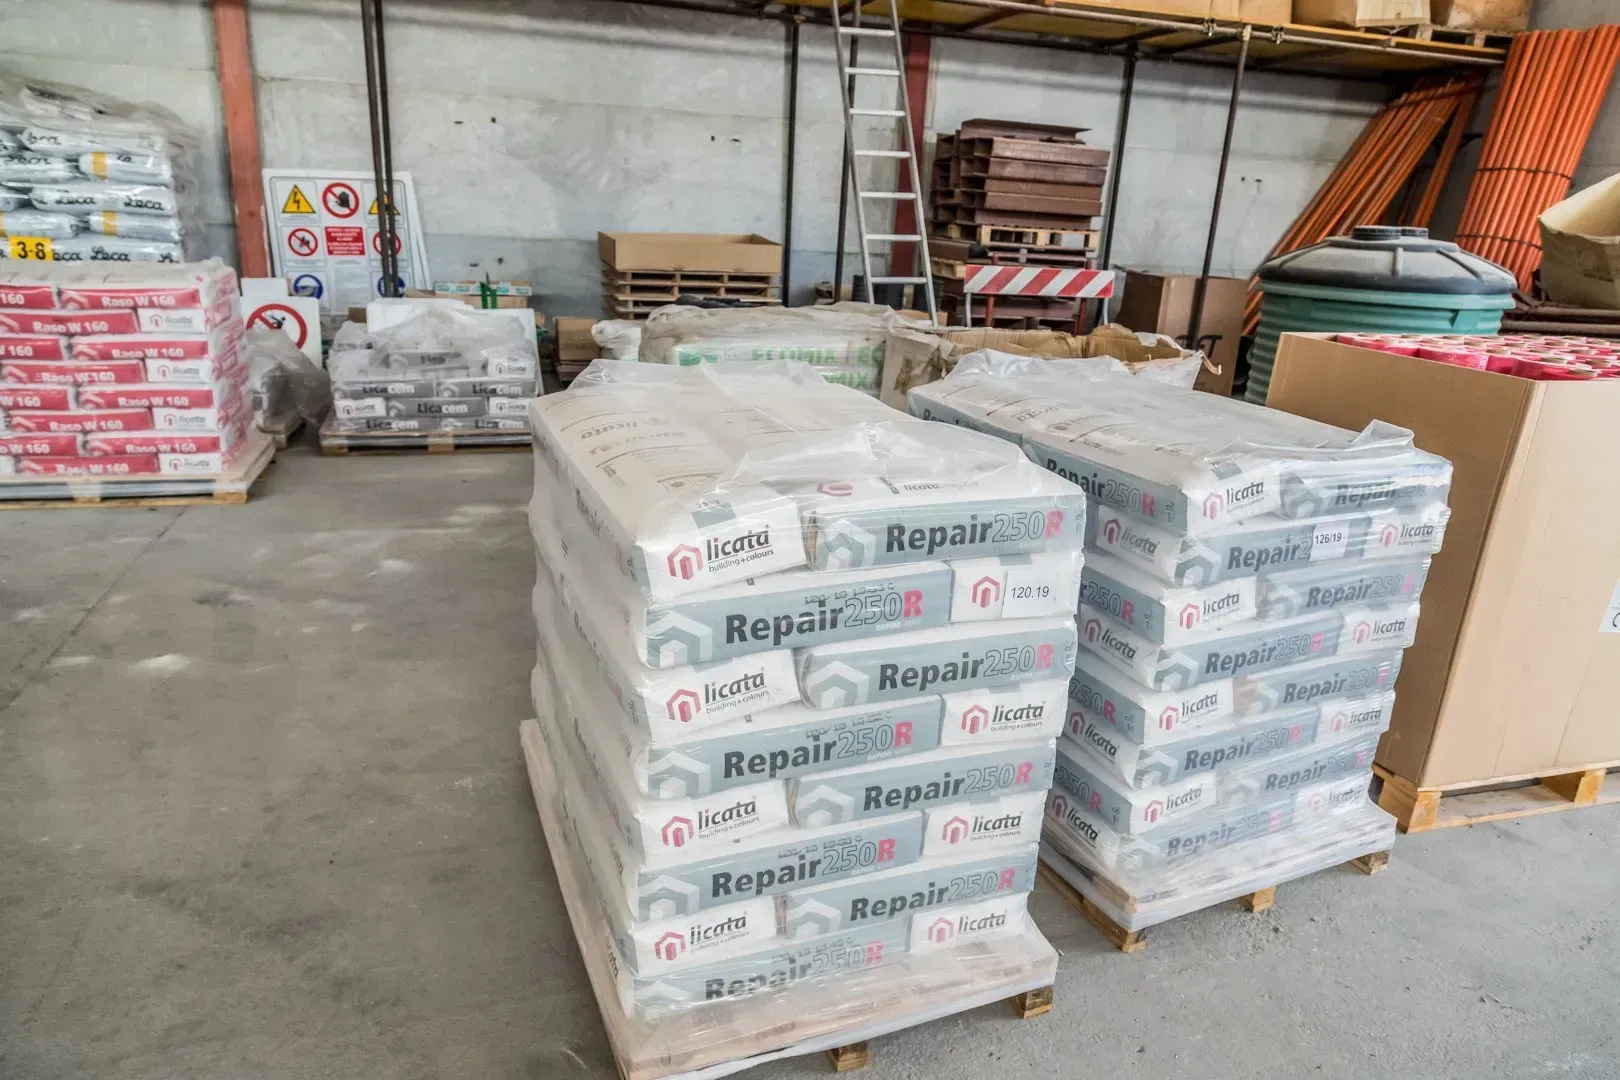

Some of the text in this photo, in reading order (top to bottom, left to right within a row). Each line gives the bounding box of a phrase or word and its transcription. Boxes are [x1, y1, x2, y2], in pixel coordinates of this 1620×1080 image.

[16, 240, 47, 260] 3-8
[52, 248, 83, 261] eca
[134, 295, 149, 307] W
[151, 294, 176, 307] 160
[67, 321, 82, 333] W
[83, 320, 109, 333] 160
[8, 345, 34, 357] 160
[144, 347, 159, 358] W
[160, 347, 185, 358] 160
[16, 395, 42, 407] 160
[150, 396, 164, 406] W
[166, 395, 190, 407] 160
[417, 402, 469, 415] Licacem
[82, 420, 97, 431] W
[99, 419, 124, 431] 160
[26, 443, 51, 454] 160
[158, 443, 172, 454] W
[173, 442, 197, 454] 160
[1226, 481, 1264, 505] licata
[1121, 527, 1158, 554] licata
[1314, 532, 1342, 545] 126/19
[1401, 523, 1435, 538] licata
[706, 530, 770, 562] licata
[1011, 585, 1050, 599] 120.19
[1203, 592, 1240, 616] licata
[1373, 620, 1406, 635] licata
[1102, 628, 1137, 660] licata
[879, 644, 1054, 691] Repair250R
[704, 669, 766, 705] licata
[992, 703, 1044, 723] licata
[1182, 692, 1218, 717] licata
[724, 721, 913, 779] Repair250R
[1085, 723, 1118, 758] licata
[863, 761, 1034, 811] Repair250R
[1167, 785, 1202, 811] licata
[698, 799, 757, 831] licata
[972, 814, 1022, 833] licata
[1067, 806, 1099, 842] licata
[711, 838, 896, 898] Repair250R
[850, 868, 1016, 921] Repair250R
[690, 912, 747, 945] licata
[958, 911, 1007, 933] licata
